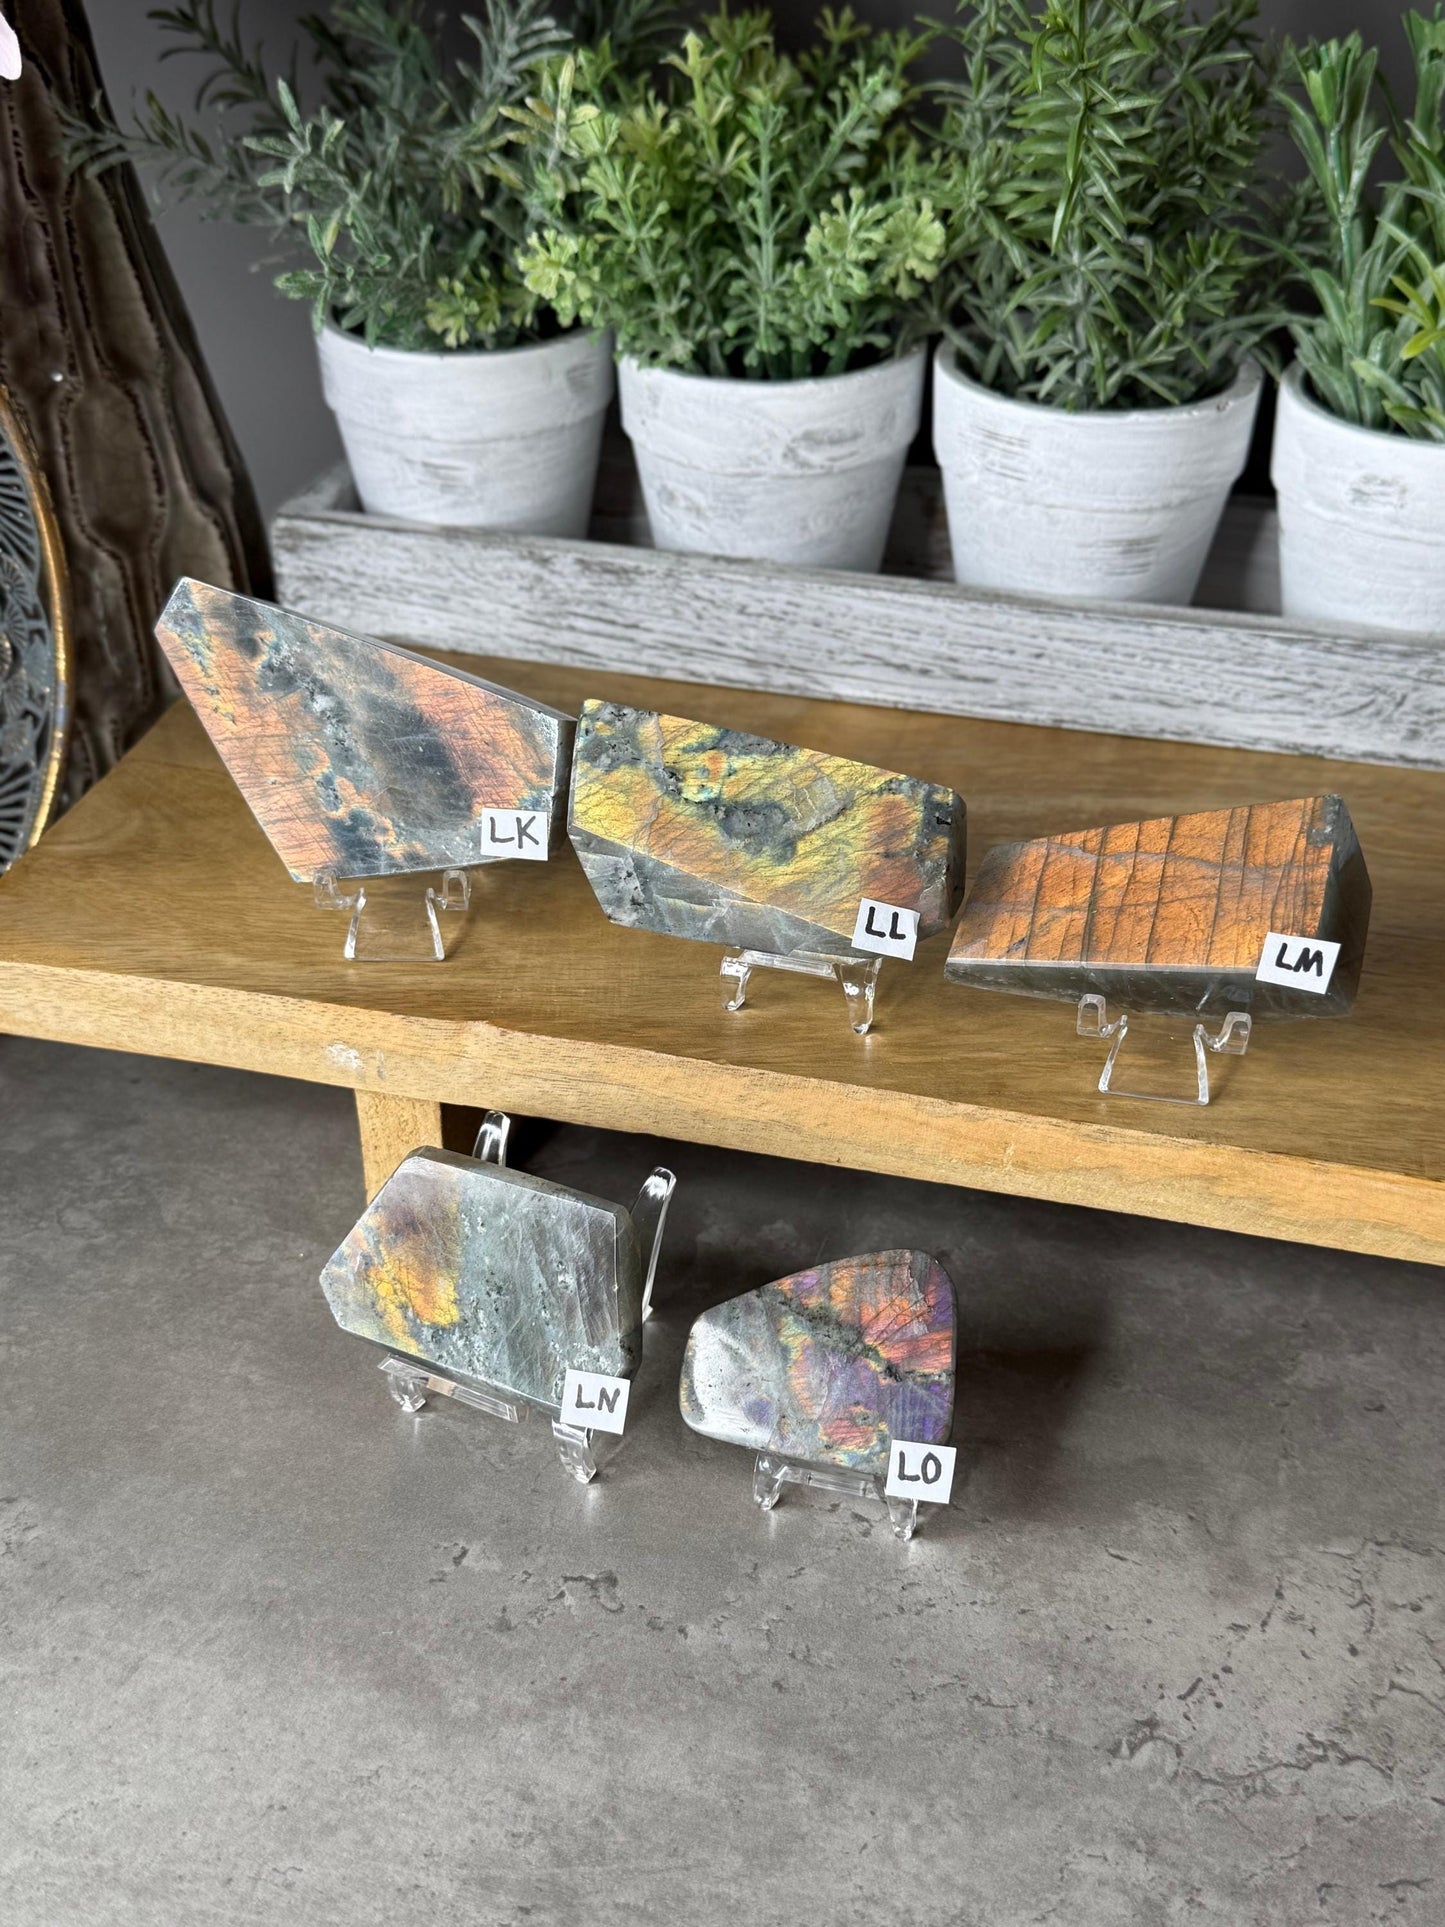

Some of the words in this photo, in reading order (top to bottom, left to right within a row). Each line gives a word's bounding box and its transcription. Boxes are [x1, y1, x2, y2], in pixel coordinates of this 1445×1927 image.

[489, 815, 539, 849] LK
[864, 905, 907, 940] LL
[1275, 942, 1324, 977] LM
[575, 1383, 621, 1414] LN
[897, 1450, 942, 1485] LO
